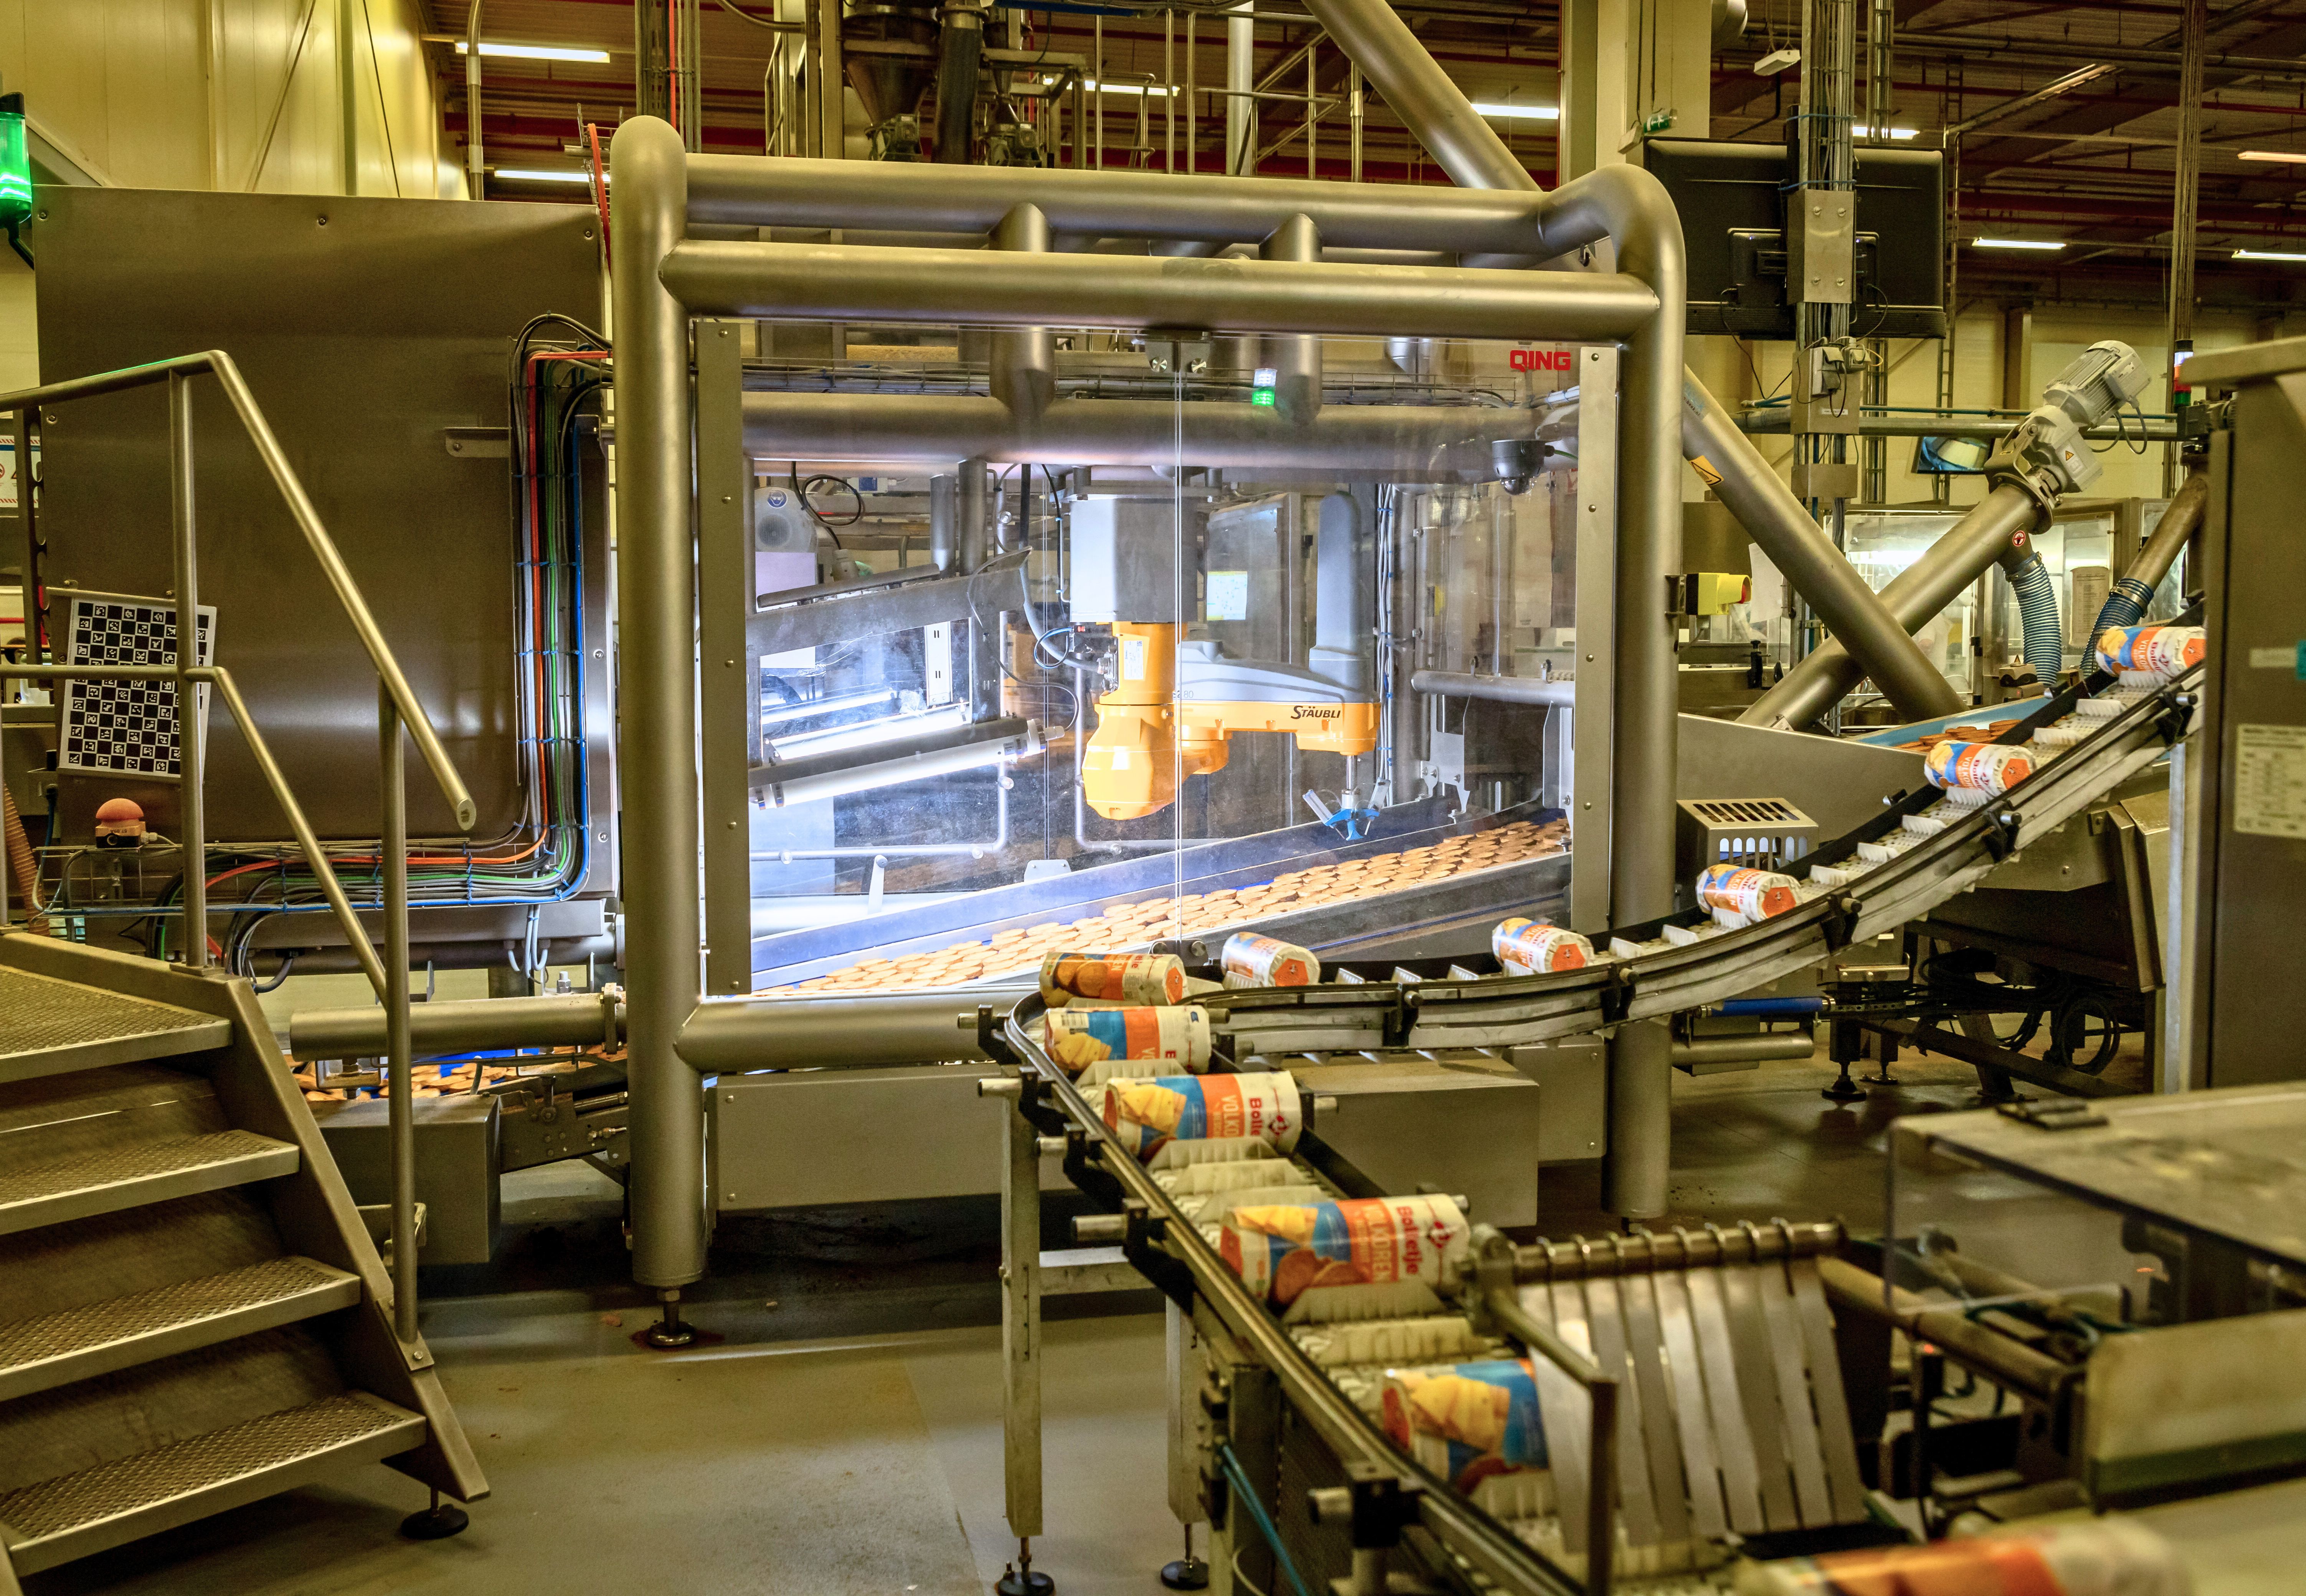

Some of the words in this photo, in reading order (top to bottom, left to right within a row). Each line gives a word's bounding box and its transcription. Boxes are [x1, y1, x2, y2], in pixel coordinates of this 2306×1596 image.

[1510, 350, 1571, 373] QING
[1291, 705, 1341, 720] STÄUBLI
[1729, 871, 1752, 906] VOLKOEN
[1396, 1206, 1423, 1275] Bolletje
